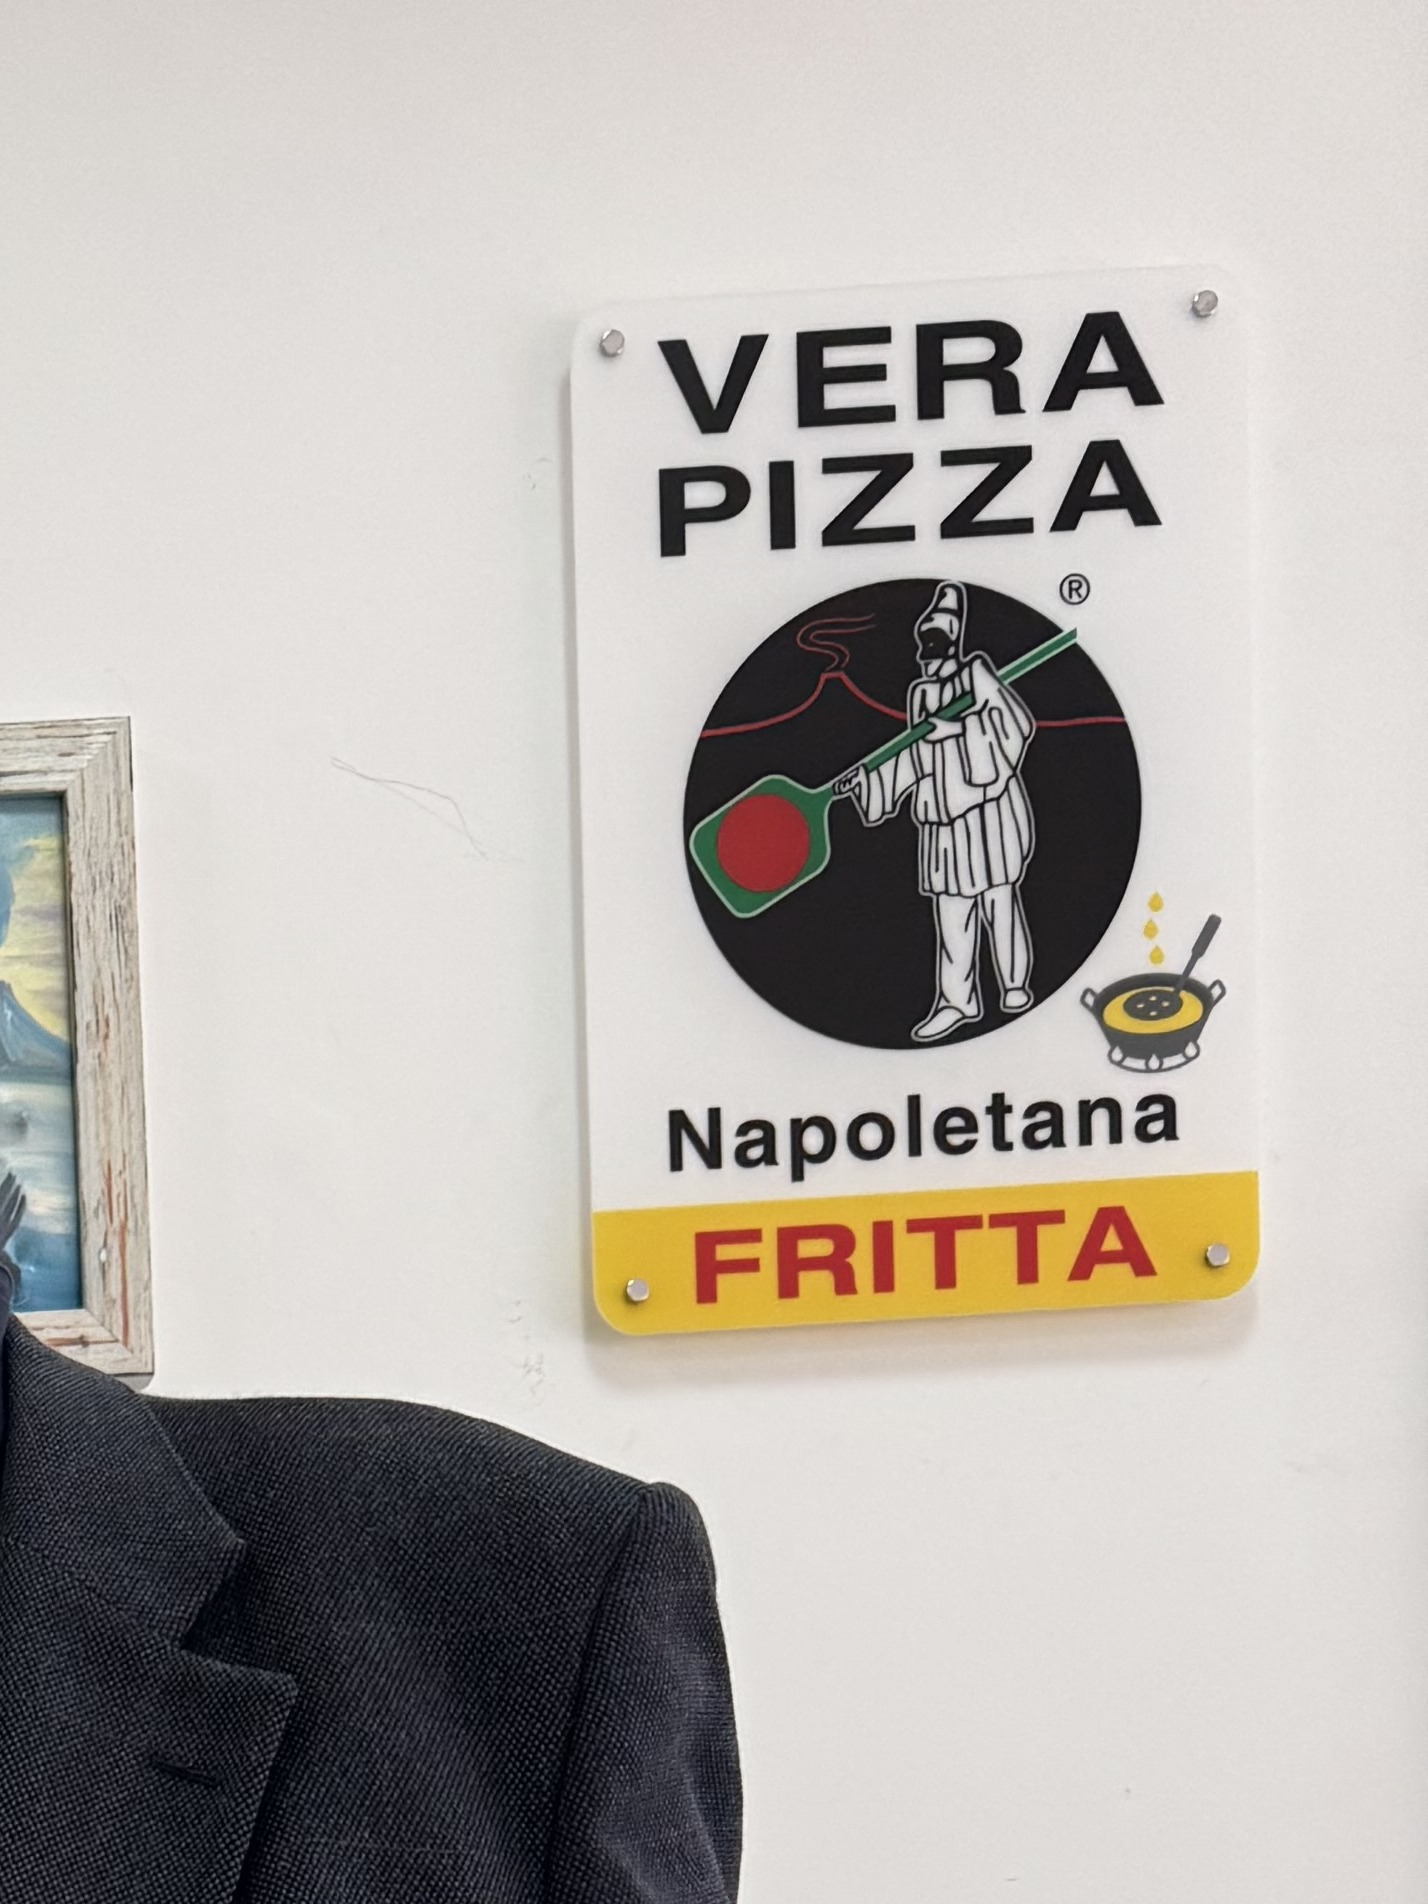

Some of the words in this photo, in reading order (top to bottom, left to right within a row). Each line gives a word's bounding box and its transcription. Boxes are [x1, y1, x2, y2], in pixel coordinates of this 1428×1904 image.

[657, 310, 1165, 435] VERA
[658, 438, 1163, 558] PIZZA
[667, 1090, 1181, 1183] Napoletana
[693, 1205, 1159, 1305] FRITTA
